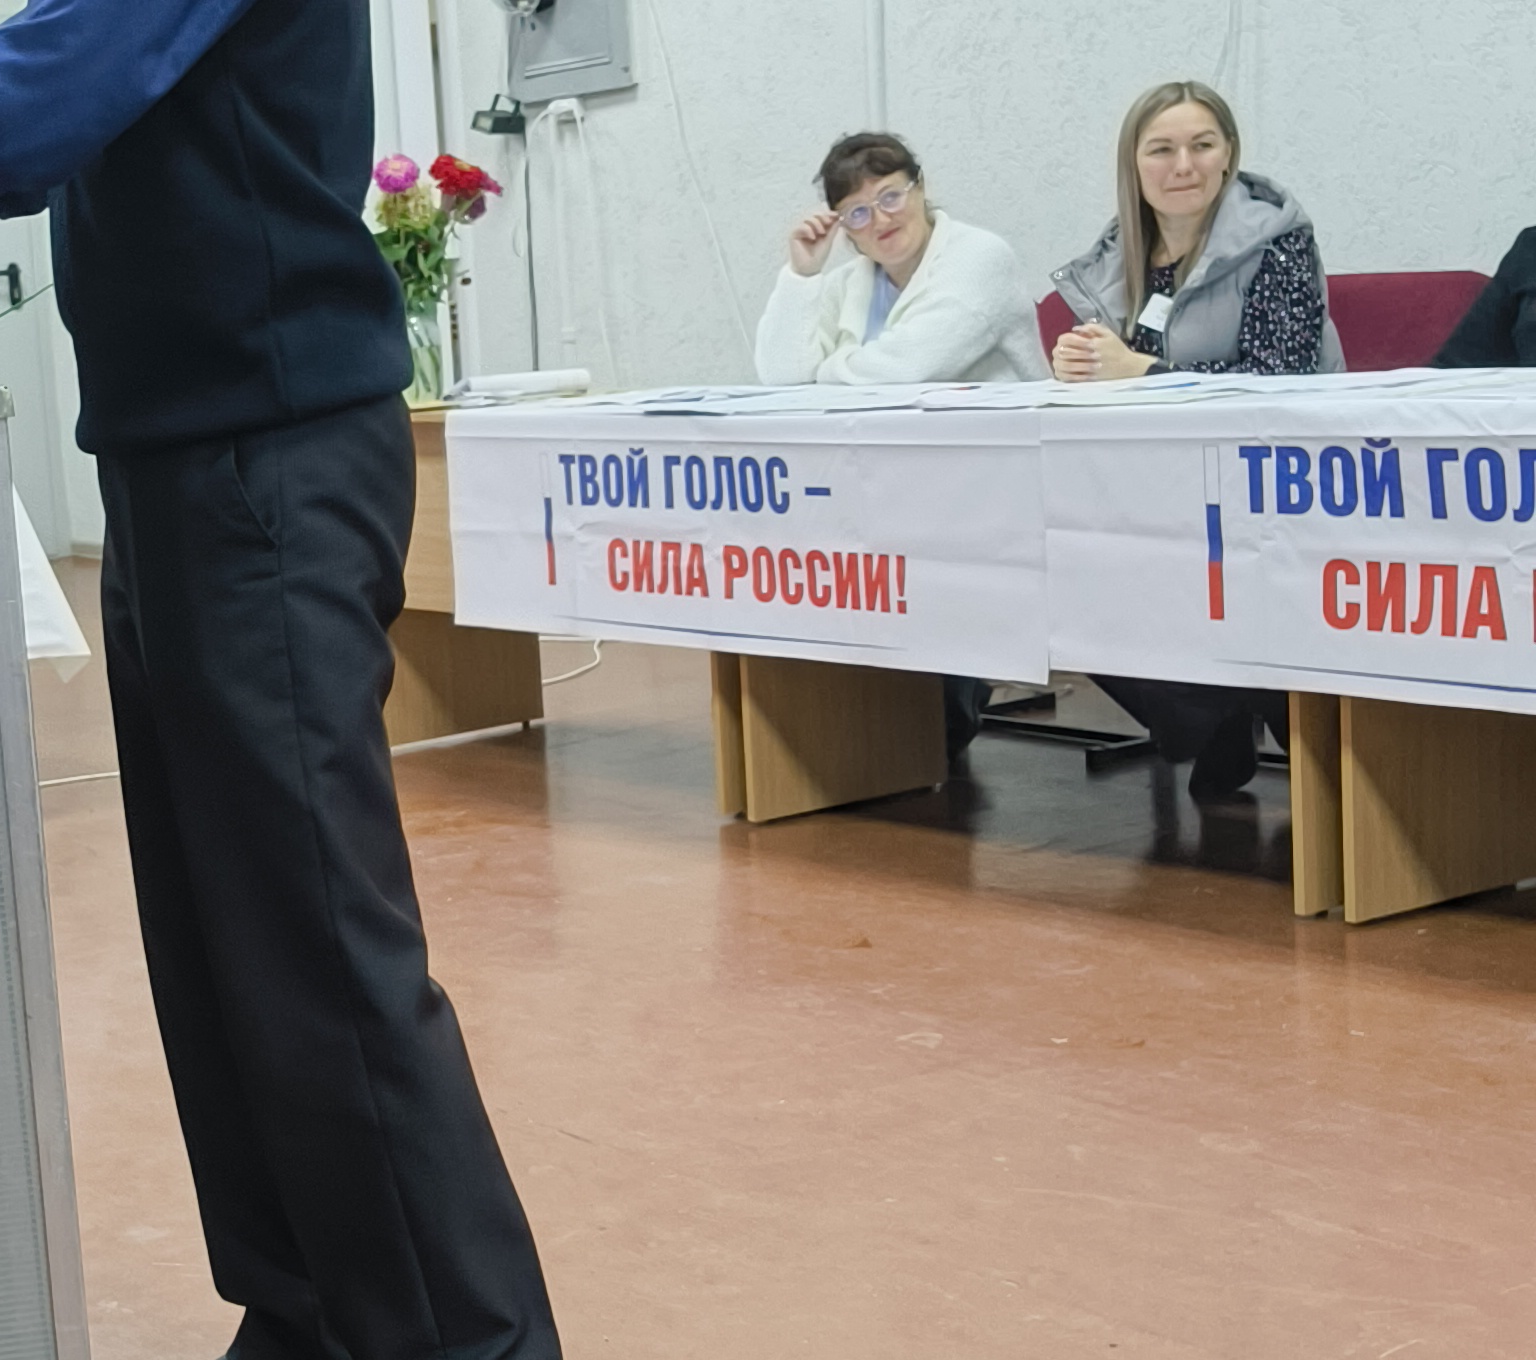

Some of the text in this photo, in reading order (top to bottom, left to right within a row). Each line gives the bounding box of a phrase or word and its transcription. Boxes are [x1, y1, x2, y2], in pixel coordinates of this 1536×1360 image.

[558, 446, 650, 509] ТВОЙ
[662, 454, 790, 515] ГОЛОС
[1238, 437, 1405, 519] ТВОЙ
[607, 538, 908, 615] СИЛА РОССИИ!
[1322, 558, 1507, 641] СИЛА
